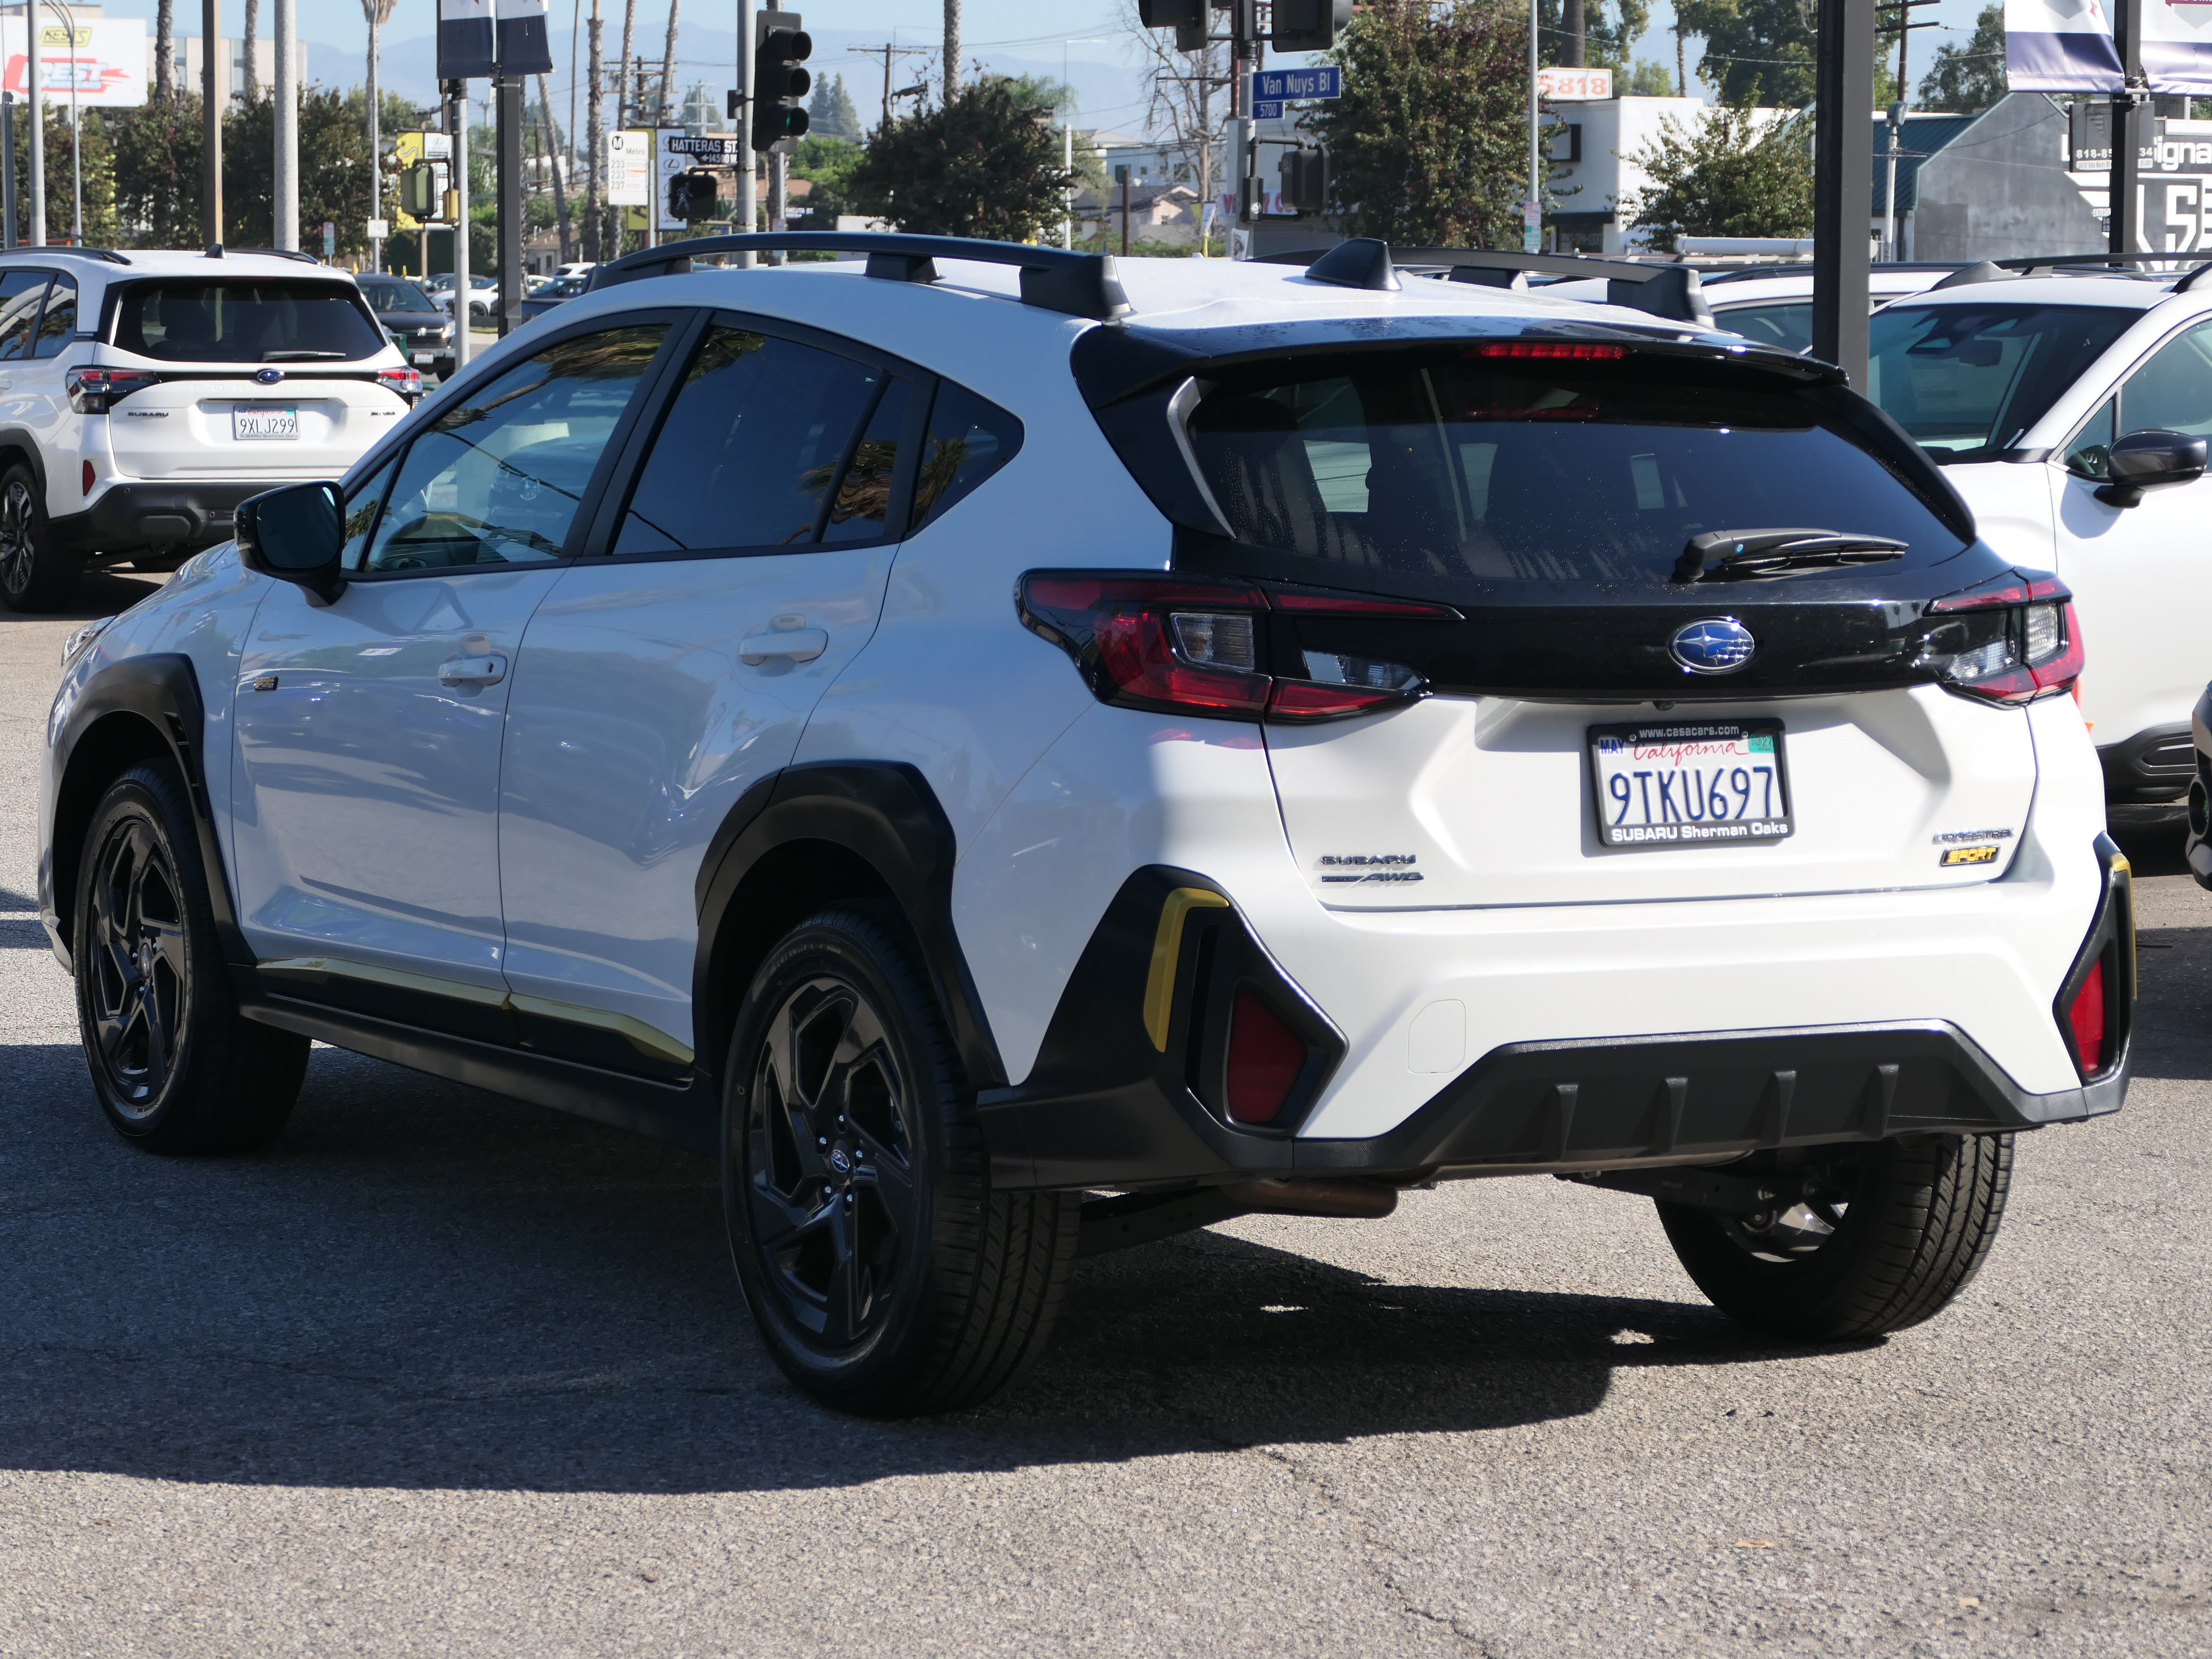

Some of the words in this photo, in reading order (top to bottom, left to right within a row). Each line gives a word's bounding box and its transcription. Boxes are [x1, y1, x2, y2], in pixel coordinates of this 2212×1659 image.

[1262, 75, 1282, 95] Van
[1287, 74, 1314, 98] Nuys
[1538, 75, 1608, 96] 5818
[1260, 103, 1277, 117] 5700
[672, 139, 721, 152] HATTERAS
[724, 140, 738, 153] ST.
[611, 160, 625, 168] 233
[611, 170, 625, 179] 233
[611, 181, 625, 190] 237
[240, 418, 294, 433] 9XLJ299
[1639, 725, 1739, 739] www.casacars.com
[1599, 739, 1626, 755] MAY
[1634, 740, 1750, 767] California
[1610, 765, 1774, 825] 9TKU697
[1612, 825, 1678, 842] SUBARU
[1682, 824, 1748, 839] Sherman
[1751, 822, 1789, 835] Oaks
[1321, 855, 1417, 865] SUBARU
[1947, 846, 1997, 863] SPORT
[1358, 872, 1425, 882] AWD
